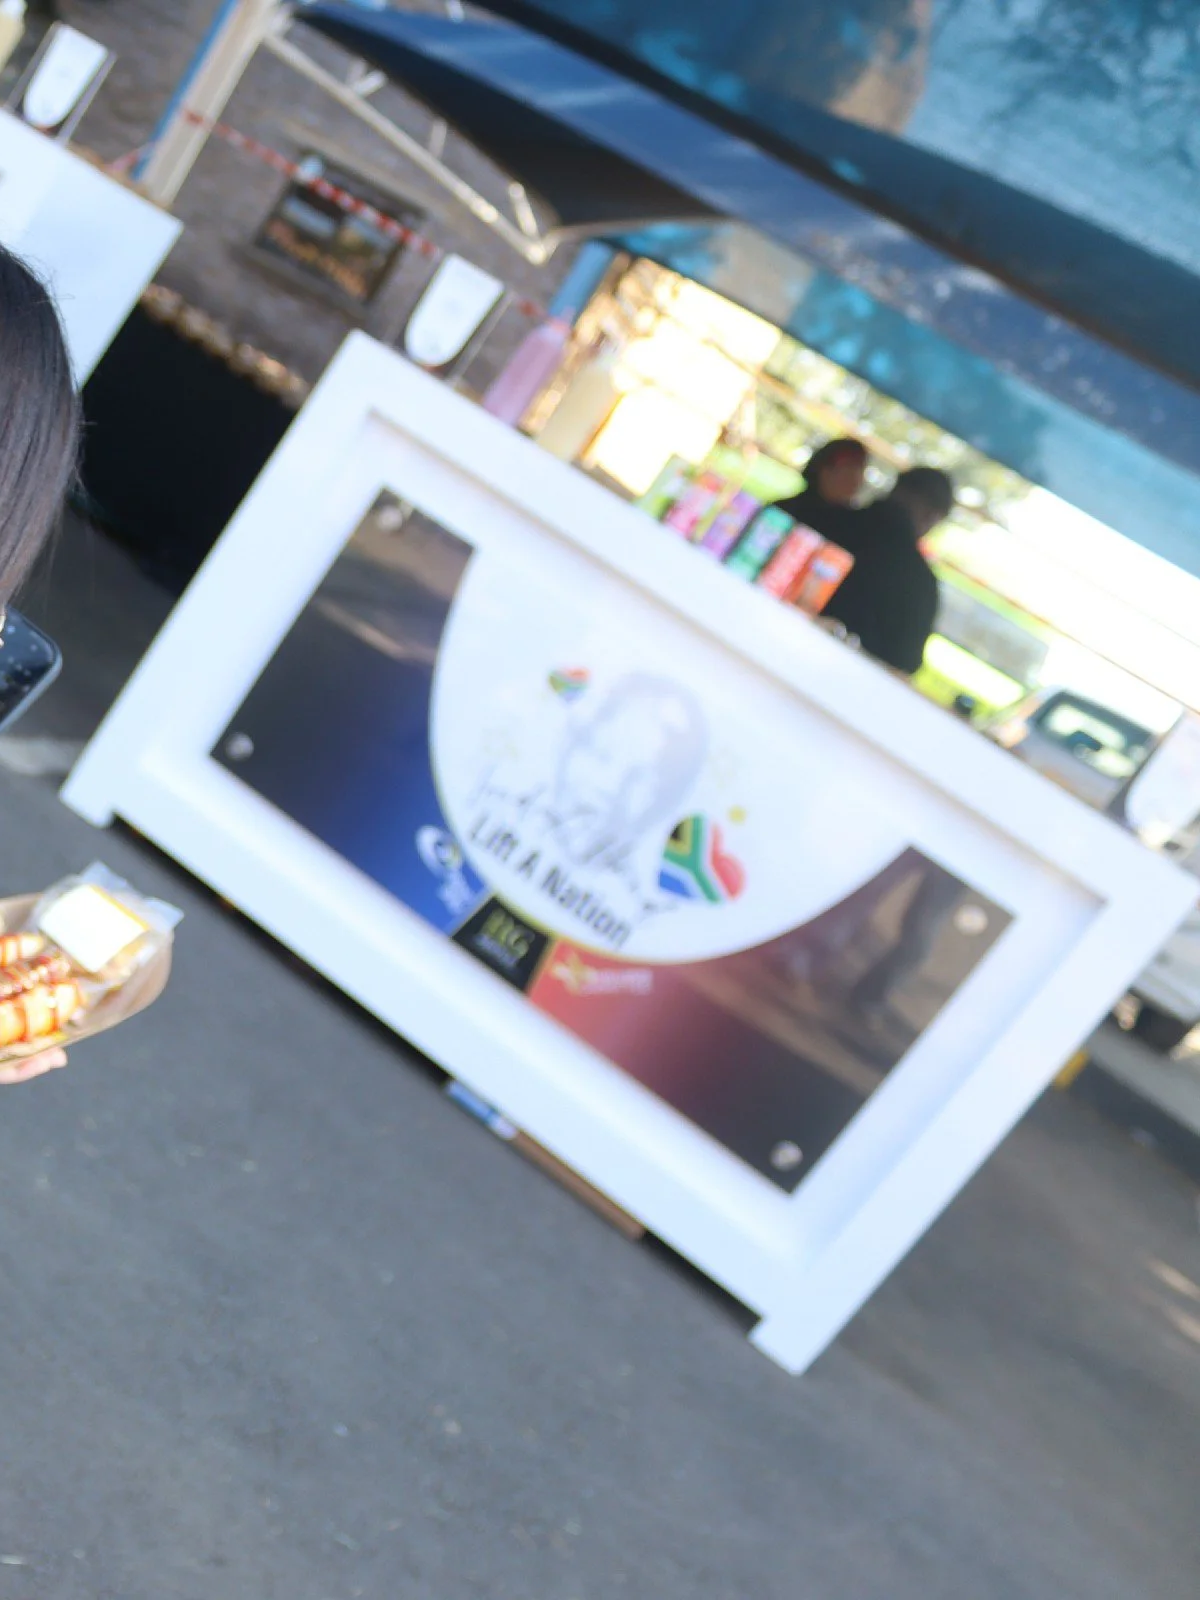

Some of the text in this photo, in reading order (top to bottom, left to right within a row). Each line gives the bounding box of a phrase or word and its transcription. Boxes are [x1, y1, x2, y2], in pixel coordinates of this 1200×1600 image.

[469, 813, 519, 862] Lift
[517, 850, 540, 879] A
[540, 866, 632, 950] Nation
